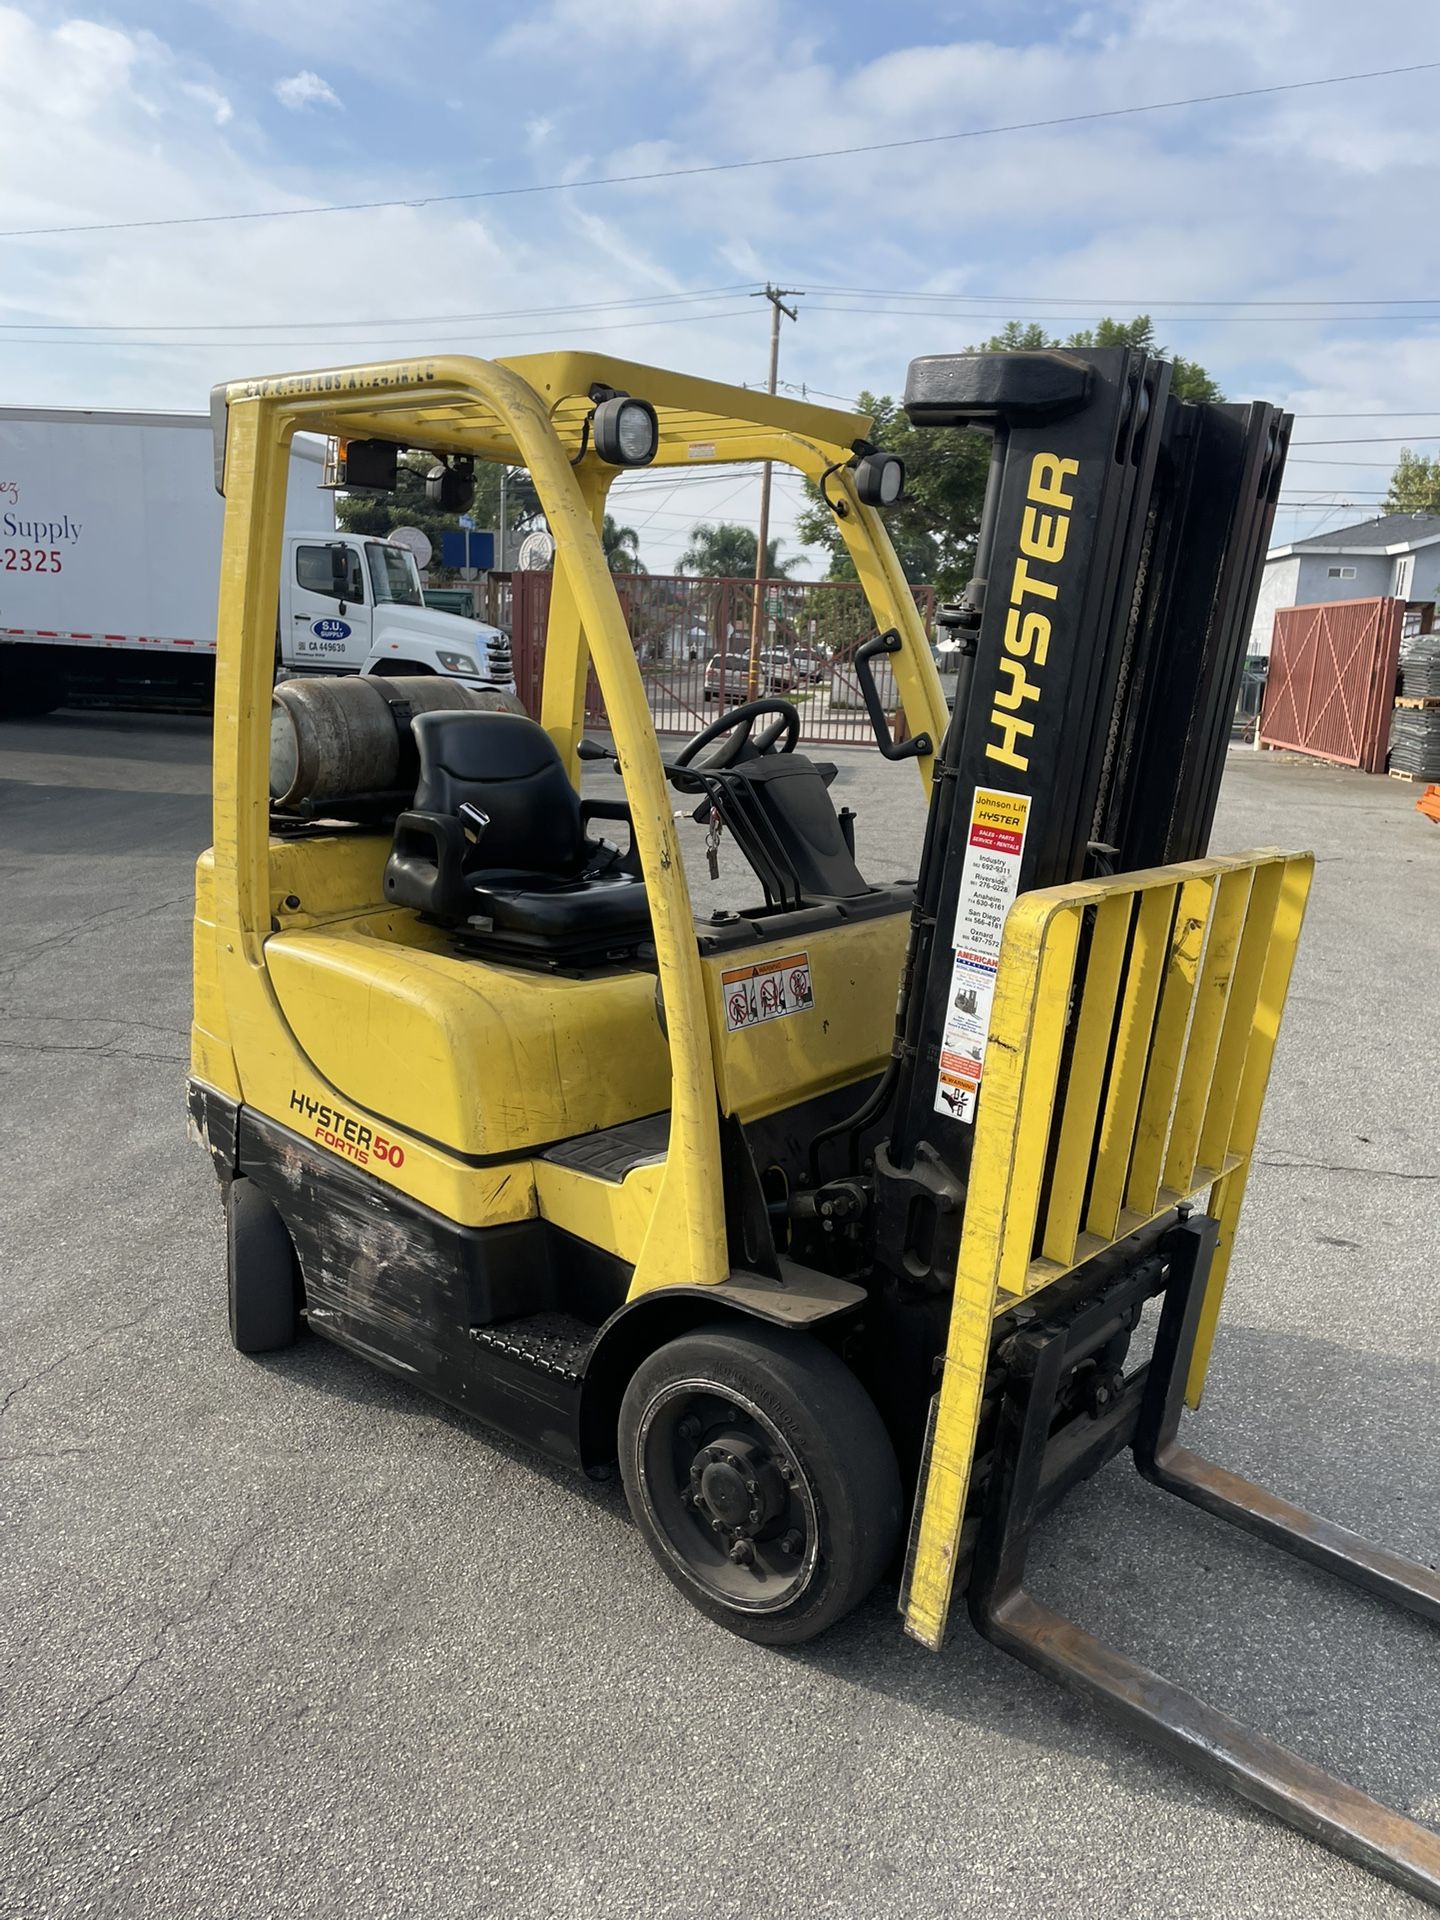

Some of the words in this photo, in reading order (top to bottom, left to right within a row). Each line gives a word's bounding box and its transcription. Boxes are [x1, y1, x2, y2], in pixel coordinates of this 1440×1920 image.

[3, 512, 83, 545] Supply
[985, 452, 1080, 772] HYSTER
[322, 620, 343, 631] S.U.
[308, 641, 318, 651] CA
[976, 796, 1011, 809] Johnson
[1013, 803, 1027, 813] Lift
[978, 810, 1020, 826] HYSTER
[972, 836, 993, 845] SERVICE
[997, 841, 1020, 850] RENTALS
[979, 830, 995, 838] SALES
[999, 834, 1015, 842] PARTS
[979, 855, 1006, 867] Industry
[975, 873, 1006, 886] Riverside
[973, 891, 1002, 903] Anaheim
[968, 908, 981, 917] San
[982, 912, 1001, 922] Diego
[970, 928, 994, 940] Oxnard
[956, 950, 999, 968] AMERICAN
[948, 1077, 976, 1091] WARNING
[290, 1089, 372, 1150] HYSTER
[373, 1135, 405, 1168] 50
[315, 1126, 369, 1165] FORTIS
